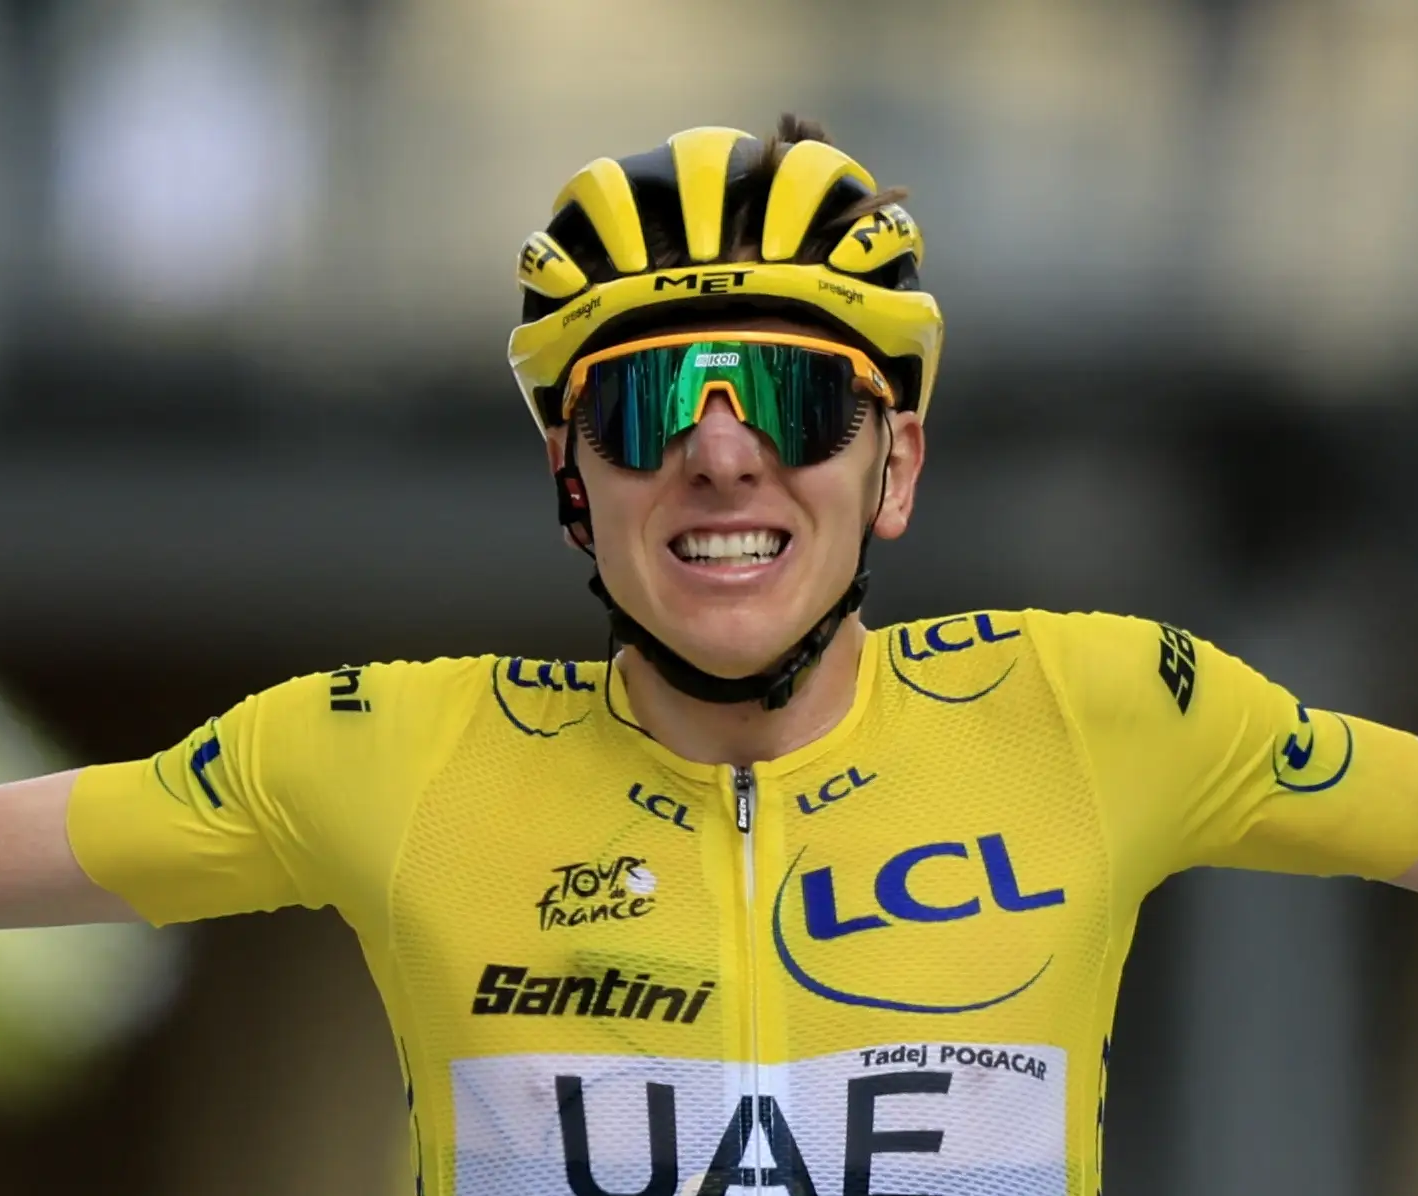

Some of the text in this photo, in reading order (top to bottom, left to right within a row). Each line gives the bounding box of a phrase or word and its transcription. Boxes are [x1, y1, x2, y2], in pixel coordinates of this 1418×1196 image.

[851, 209, 911, 254] ME
[522, 238, 566, 275] ET
[654, 270, 755, 294] MET
[817, 279, 864, 305] presight
[562, 296, 602, 329] presight
[899, 613, 1021, 661] LCL
[628, 782, 695, 832] LCL
[795, 766, 878, 815] LCL
[800, 833, 1066, 941] LCL
[471, 963, 716, 1024] Santini
[860, 1044, 1047, 1081] Tadej POGACAR
